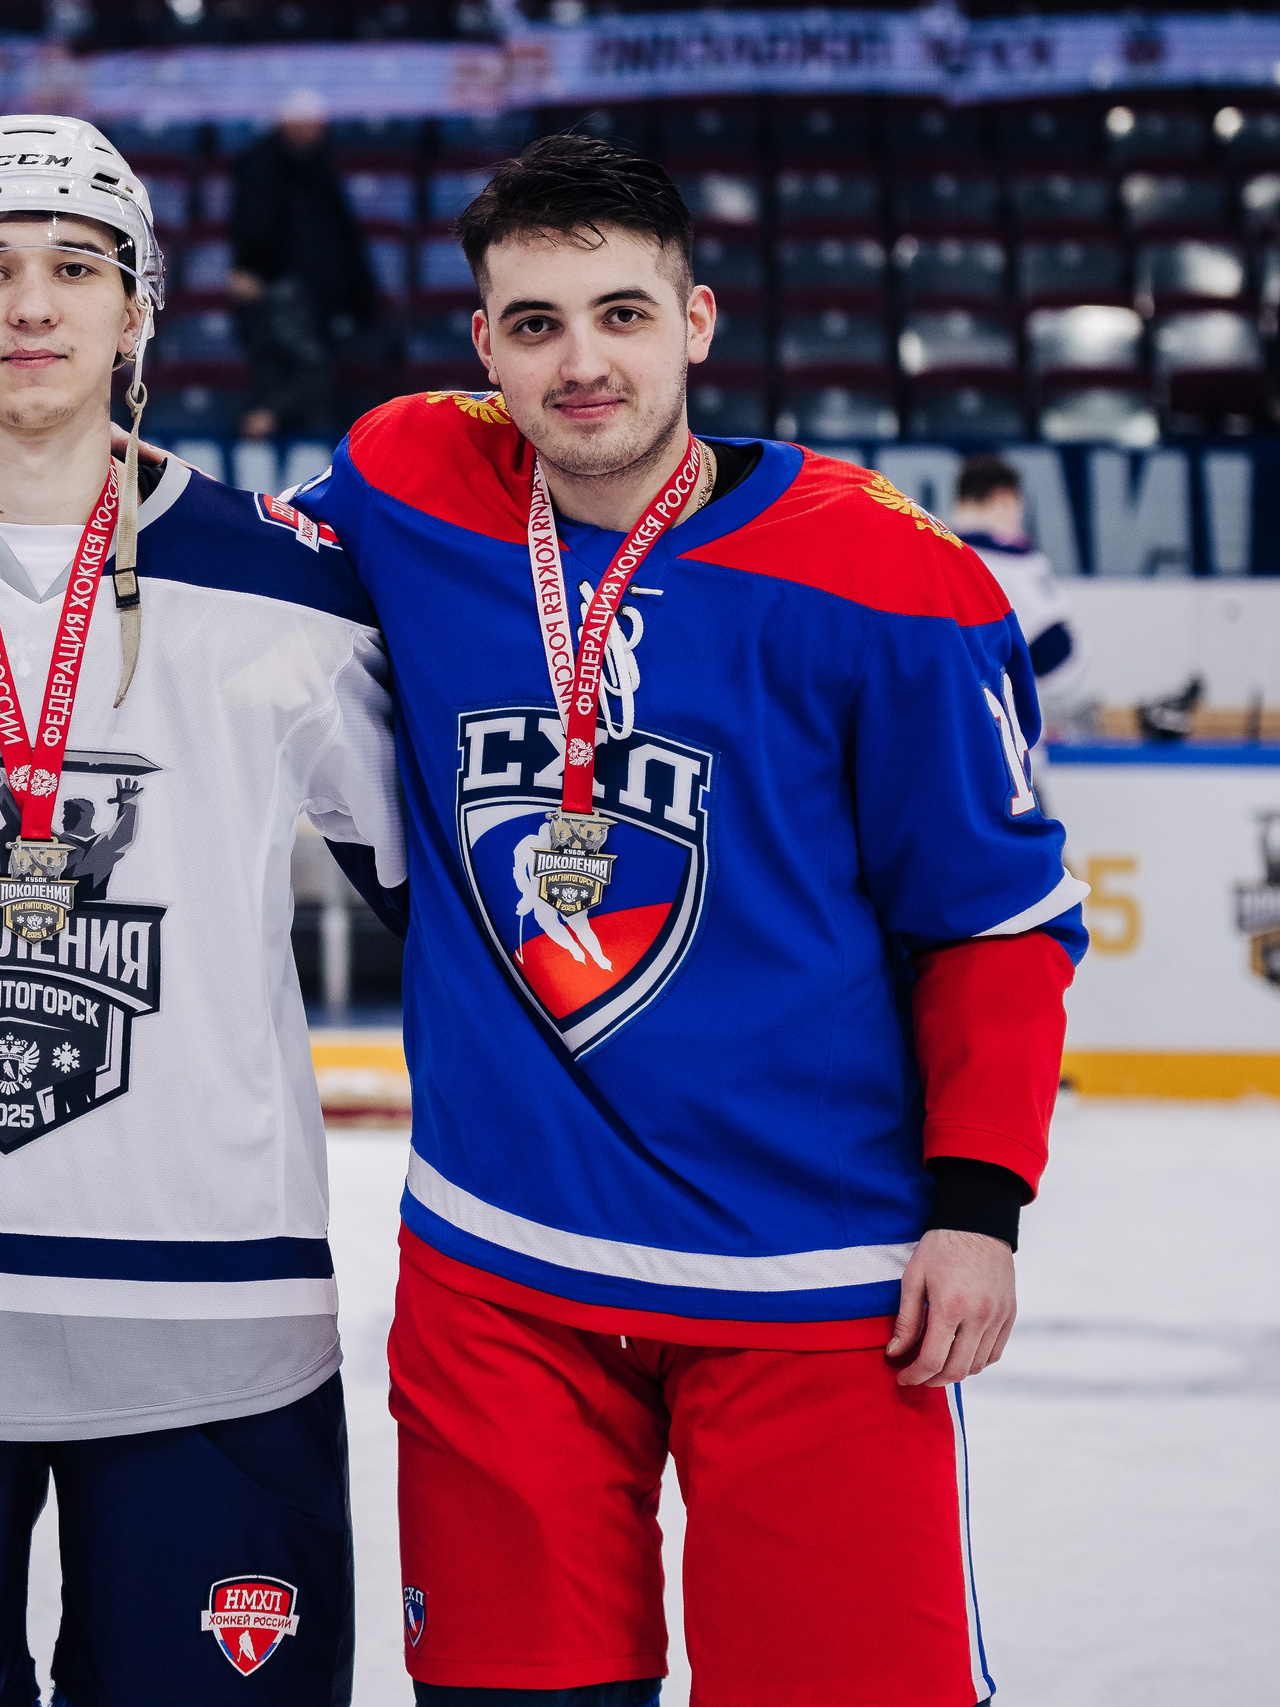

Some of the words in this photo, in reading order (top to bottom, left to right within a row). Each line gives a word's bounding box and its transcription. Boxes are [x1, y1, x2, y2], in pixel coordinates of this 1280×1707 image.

[576, 581, 621, 716] ФЕДЕРАЦИЯ
[608, 514, 665, 580] ХОККЕЯ
[655, 445, 701, 519] РОССИИ
[42, 613, 87, 747] ФЕДЕРАЦИЯ
[69, 532, 107, 610] ХОККЕЯ
[90, 464, 119, 532] РОССИИ
[537, 854, 608, 878] ПОКОЛЕНИЯ
[549, 874, 594, 887] МАГНИТОГОРСК
[0, 883, 71, 904] ПОКОЛЕНИЯ
[12, 901, 58, 914] МАГНИТОГОРСК
[26, 931, 42, 939] 2025
[223, 1588, 283, 1612] НМХЛ
[208, 1614, 251, 1626] ХОККЕЙ
[253, 1616, 292, 1629] РОССИИ
